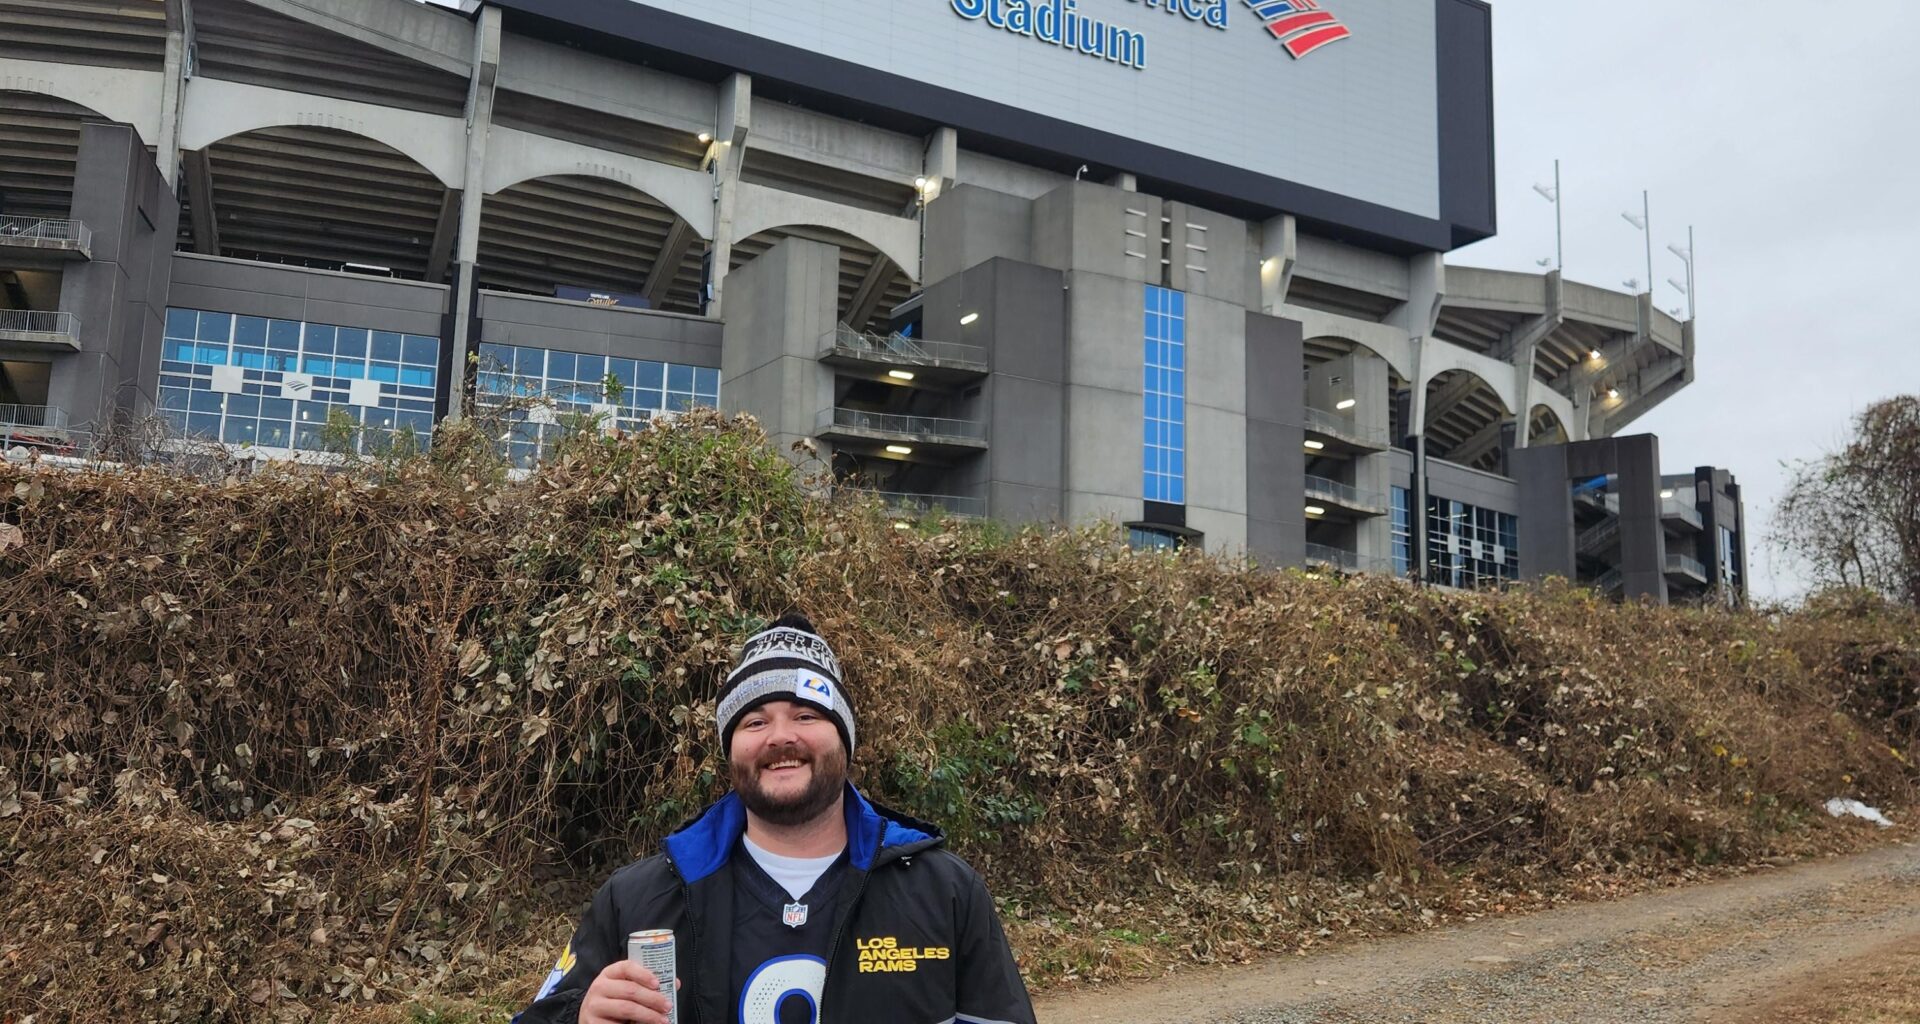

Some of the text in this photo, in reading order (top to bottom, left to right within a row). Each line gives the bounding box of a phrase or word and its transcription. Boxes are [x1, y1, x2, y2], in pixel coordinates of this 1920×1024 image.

[756, 632, 806, 645] SUPER
[786, 912, 804, 922] NFL
[857, 937, 897, 950] LOS
[858, 947, 950, 961] ANGELES
[859, 960, 917, 973] RAMS
